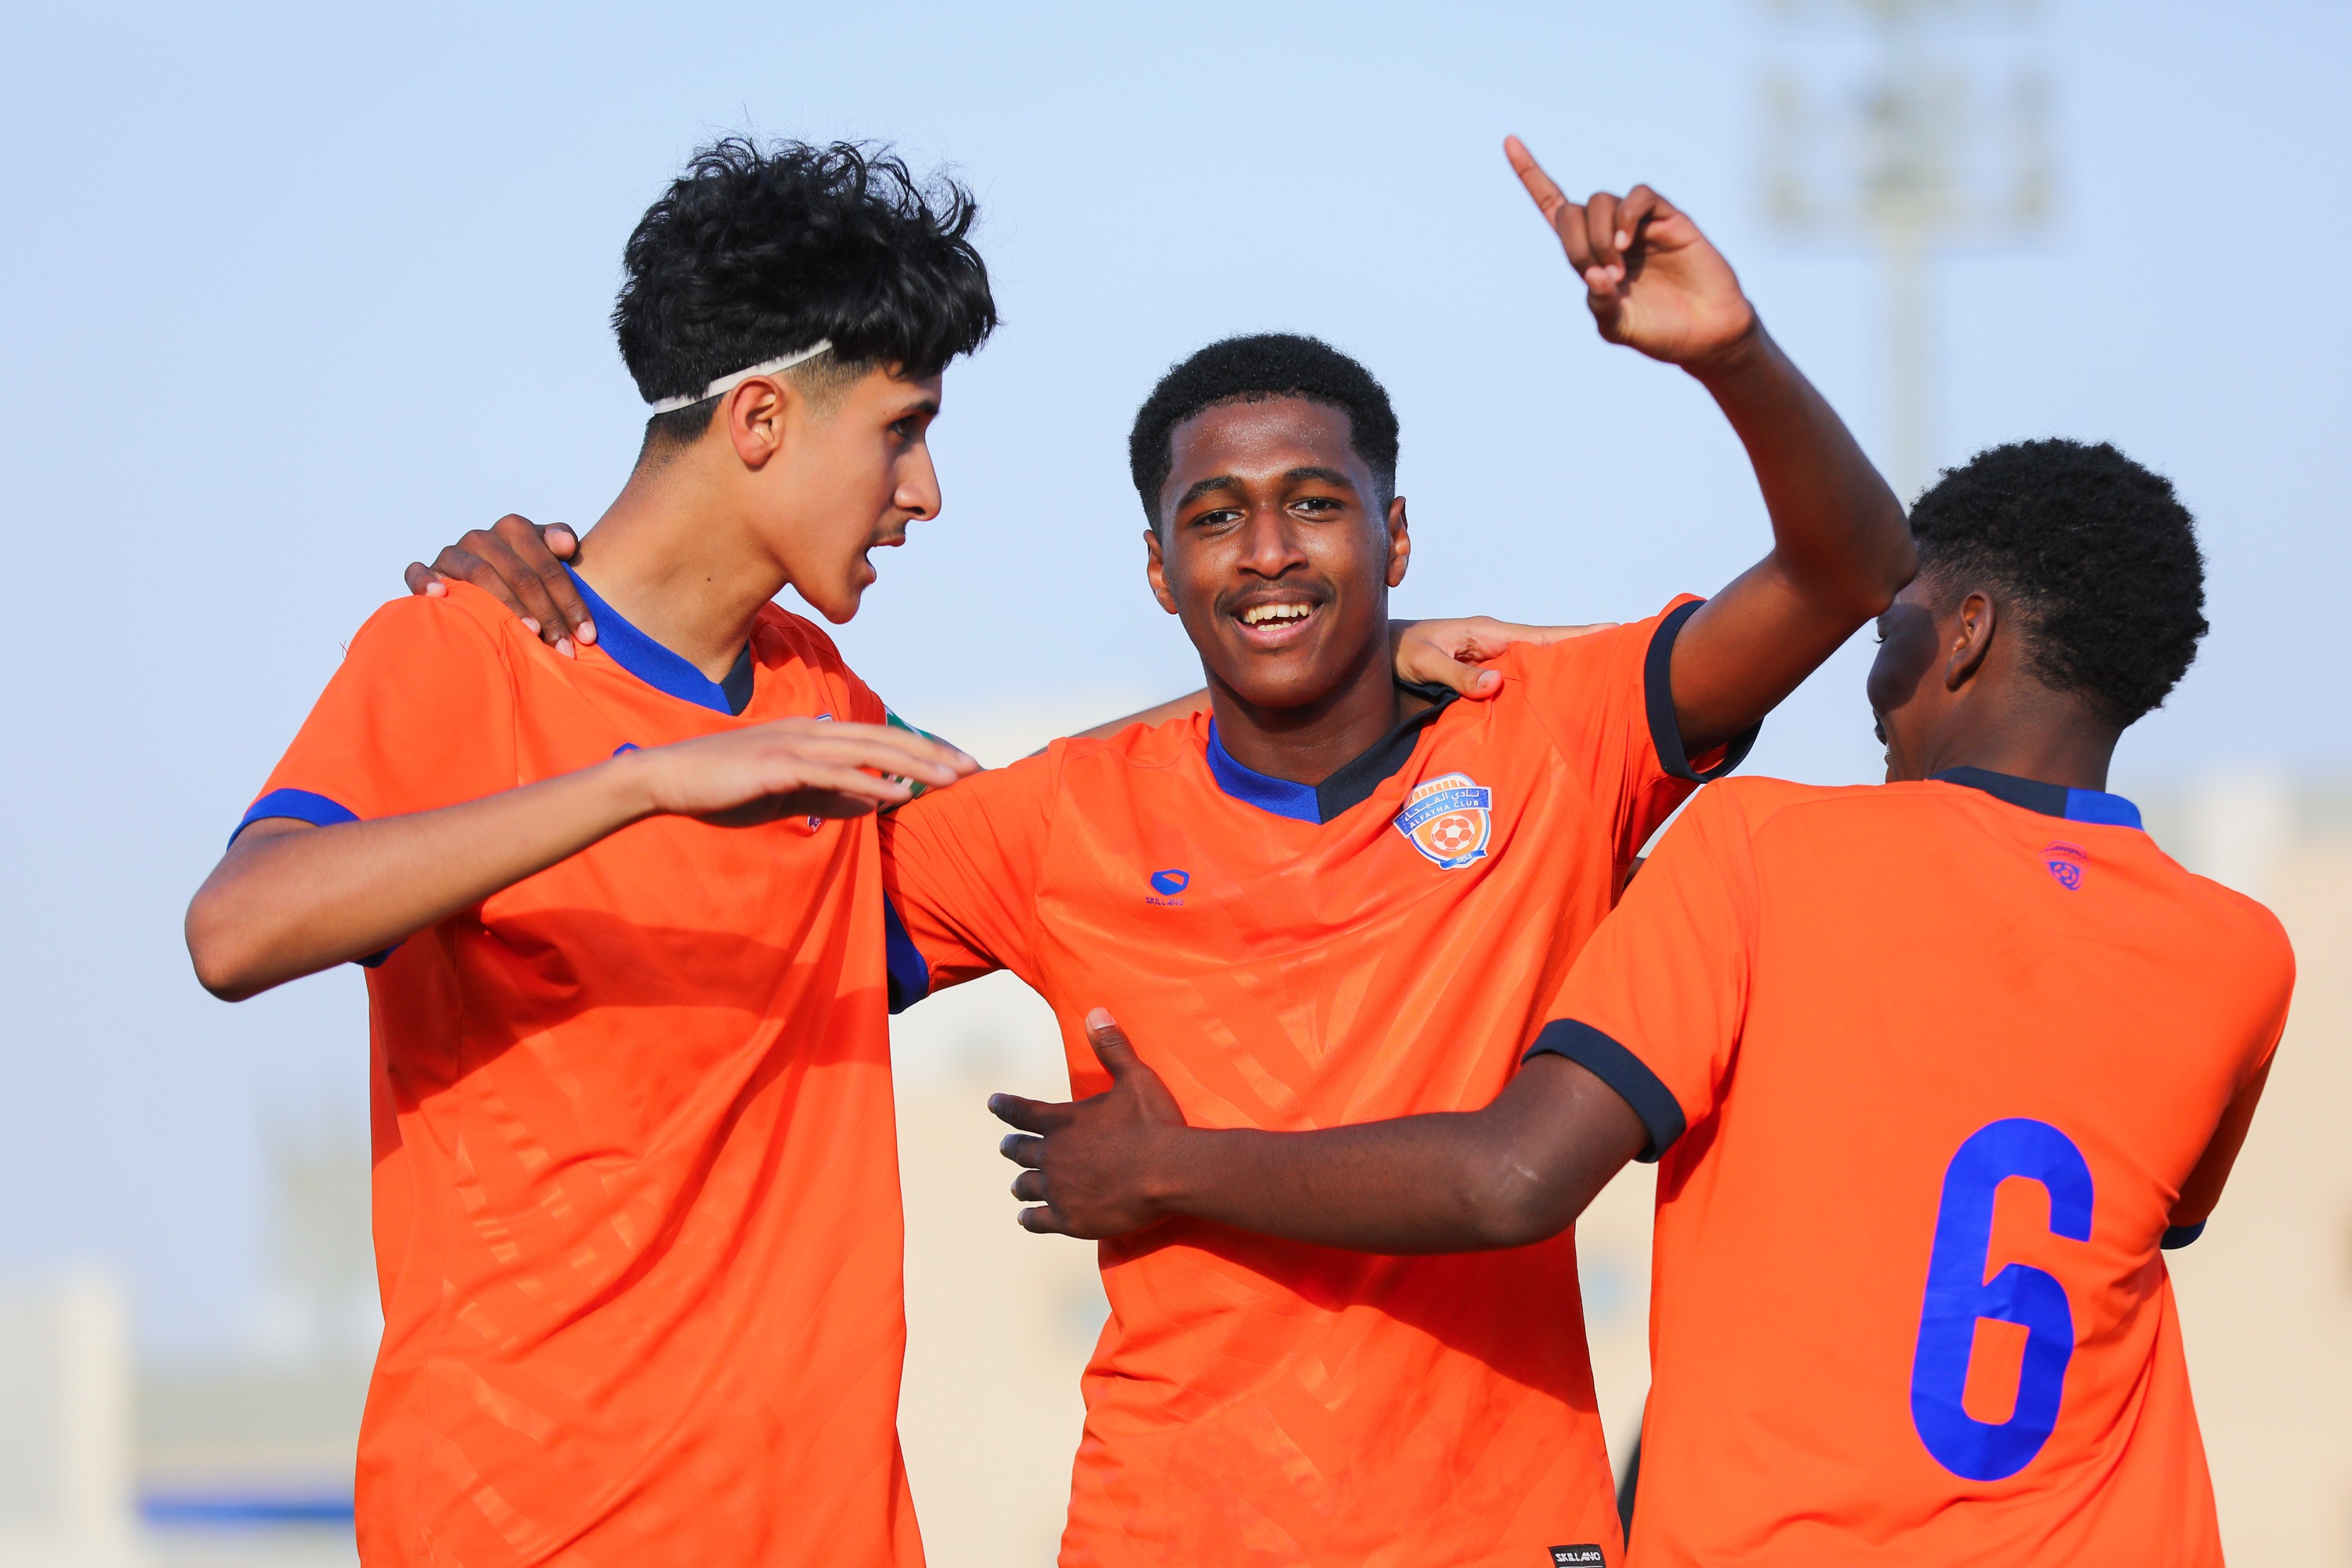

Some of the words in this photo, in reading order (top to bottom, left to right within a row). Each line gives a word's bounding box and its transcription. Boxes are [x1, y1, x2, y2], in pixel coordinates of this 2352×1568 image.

[1410, 804, 1450, 829] ALFAYHA
[1909, 1117, 2095, 1483] 6
[1555, 1552, 1601, 1562] SKILLANO
